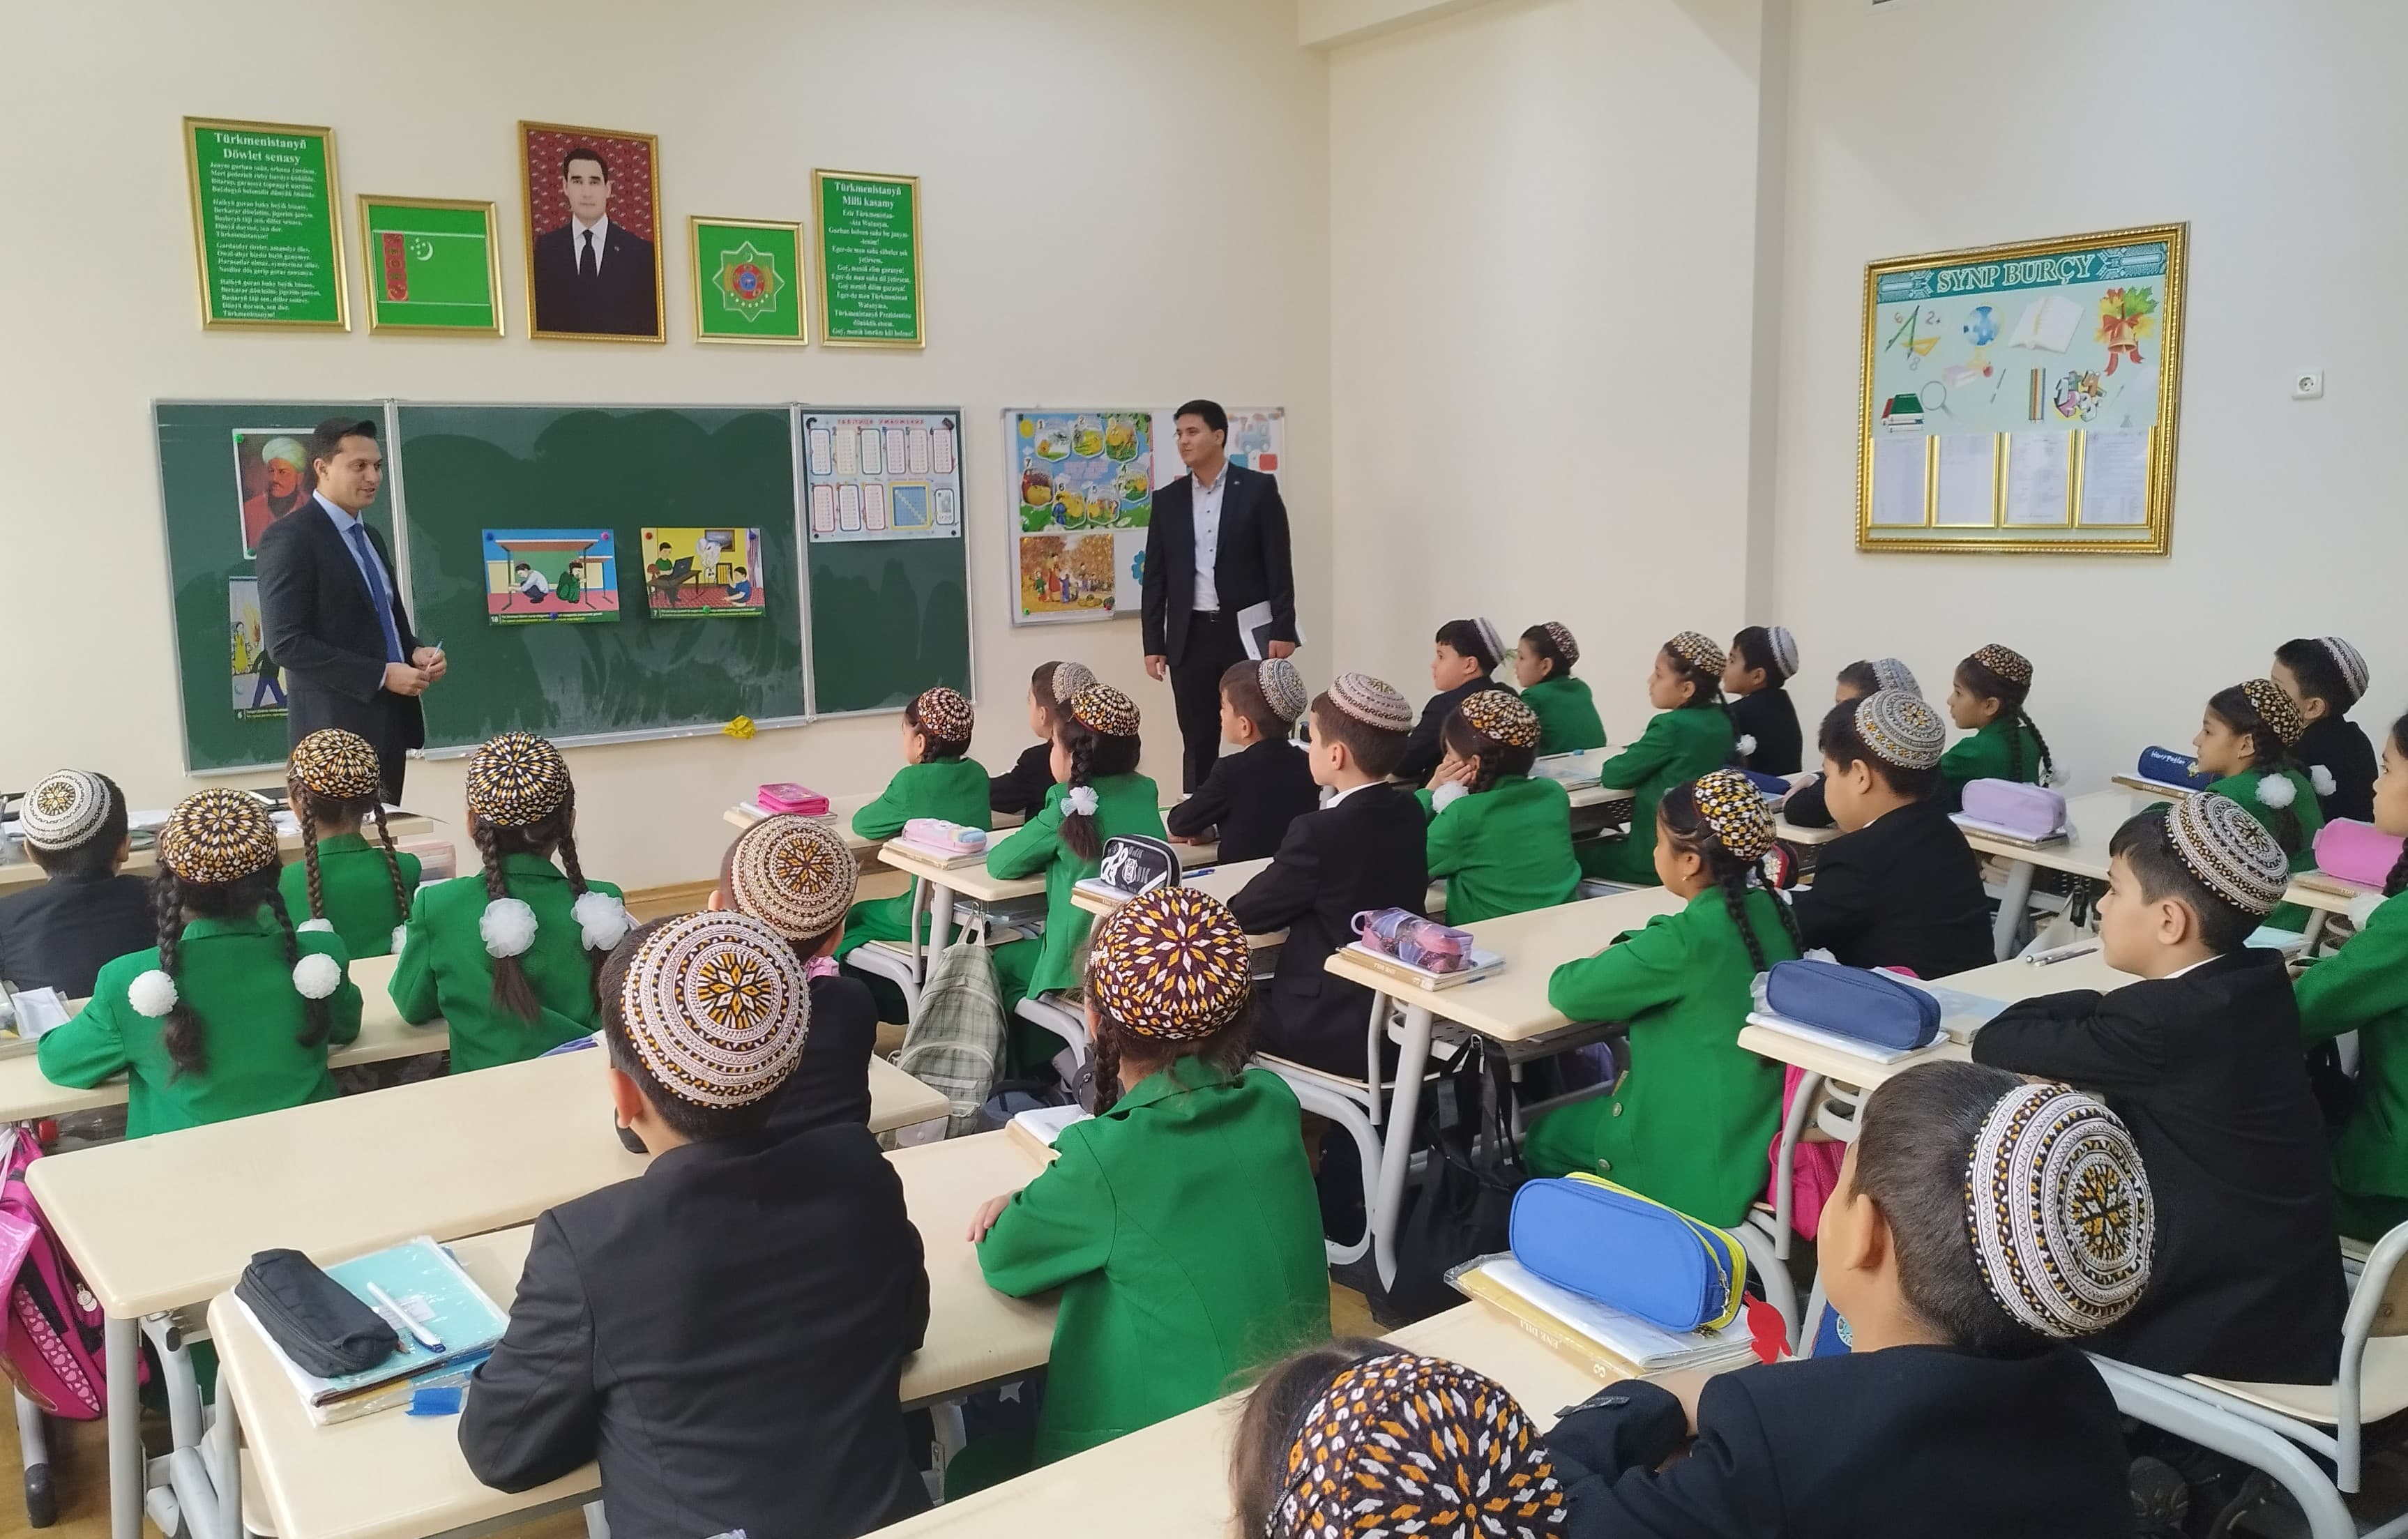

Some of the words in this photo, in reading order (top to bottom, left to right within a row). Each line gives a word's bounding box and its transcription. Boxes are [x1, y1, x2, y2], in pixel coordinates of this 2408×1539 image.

[223, 149, 263, 161] Döwlet
[265, 153, 301, 165] senasy
[842, 195, 862, 206] Milli
[863, 197, 894, 210] kasamy
[1937, 266, 2000, 294] SYNP
[2002, 254, 2095, 285] BURÇY
[1025, 458, 1031, 468] 7
